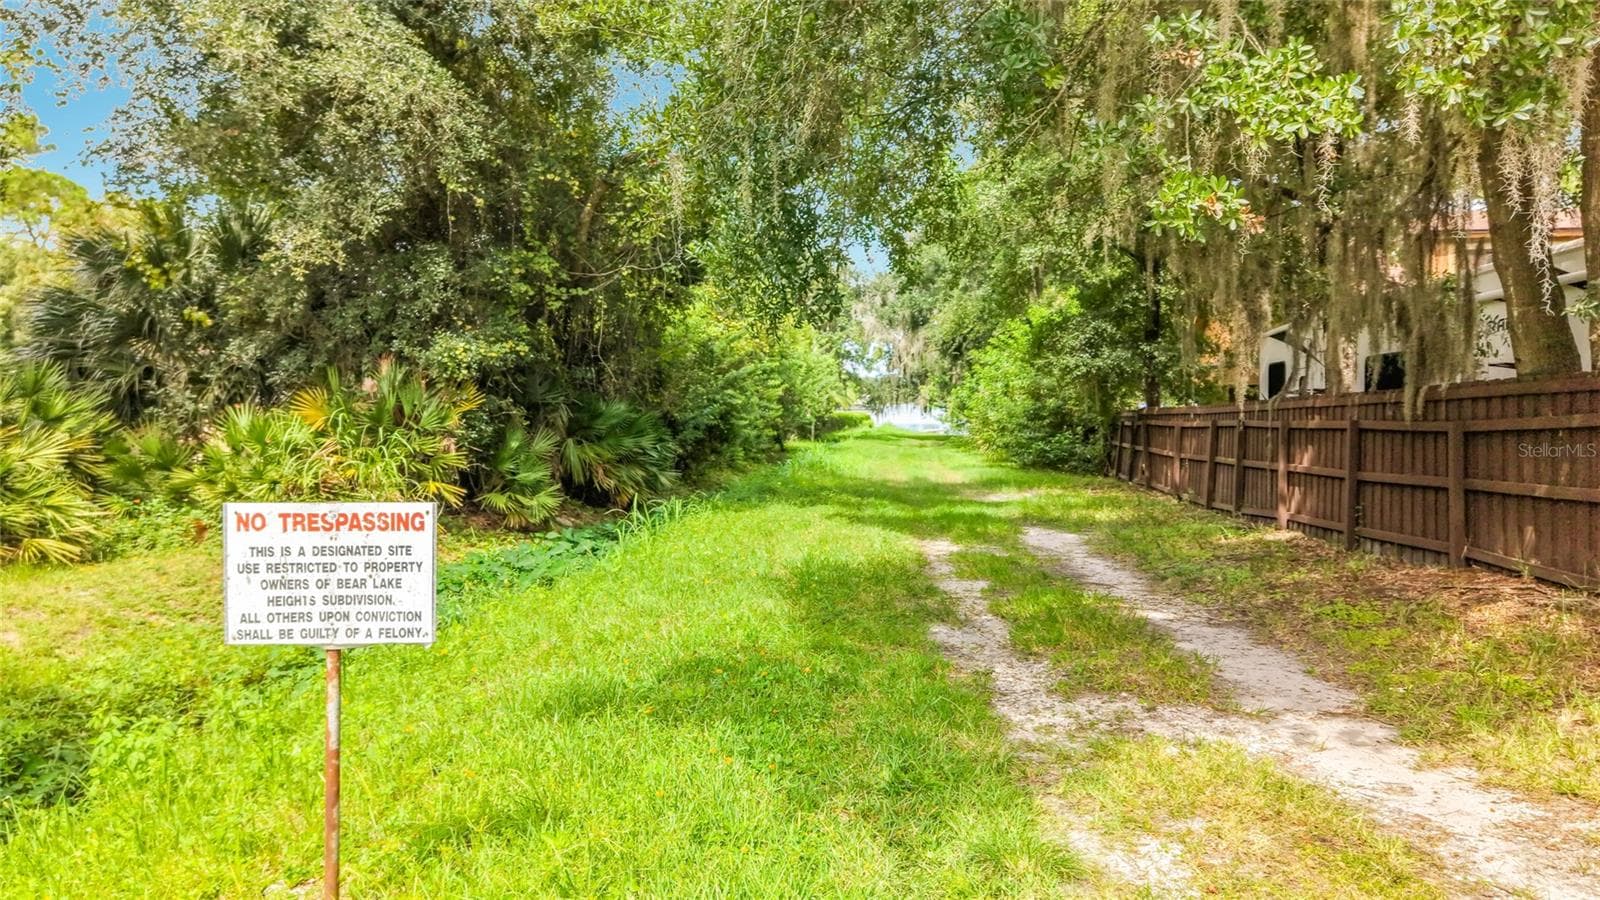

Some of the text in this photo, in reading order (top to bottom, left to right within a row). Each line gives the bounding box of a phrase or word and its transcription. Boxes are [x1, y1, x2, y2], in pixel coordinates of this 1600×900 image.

[237, 512, 425, 532] NO TRESPASSING
[249, 546, 412, 557] THIS IS A DESIGNATED SITE
[238, 562, 423, 574] USE RESTRICTED TO PROPERTY
[261, 578, 402, 590] OWNERS OF BEAR LAKE
[267, 596, 316, 606] HEIGHTS
[240, 611, 422, 623] ALL OTHERS UPON CONVICTION
[237, 627, 423, 640] SHALL BE GUILTY OF A FELONY.
